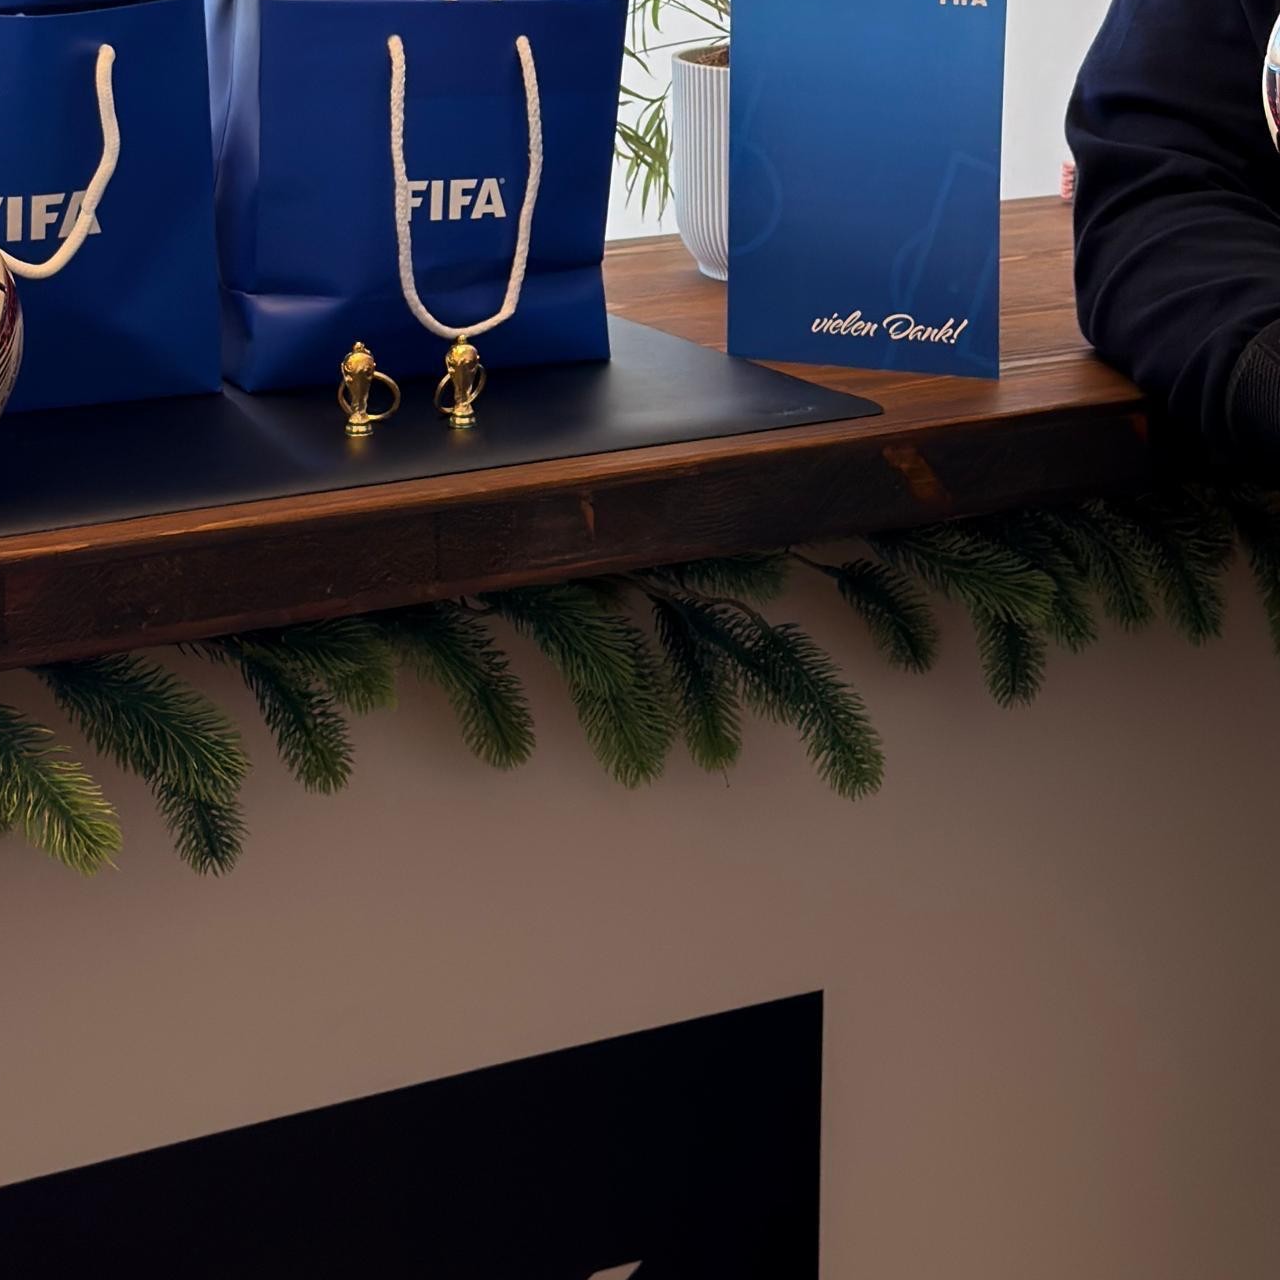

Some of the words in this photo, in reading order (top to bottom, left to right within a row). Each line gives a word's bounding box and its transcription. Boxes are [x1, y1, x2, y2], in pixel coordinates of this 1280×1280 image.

[407, 177, 507, 223] FIFA
[810, 309, 879, 338] vielen
[881, 313, 969, 345] Dank!
